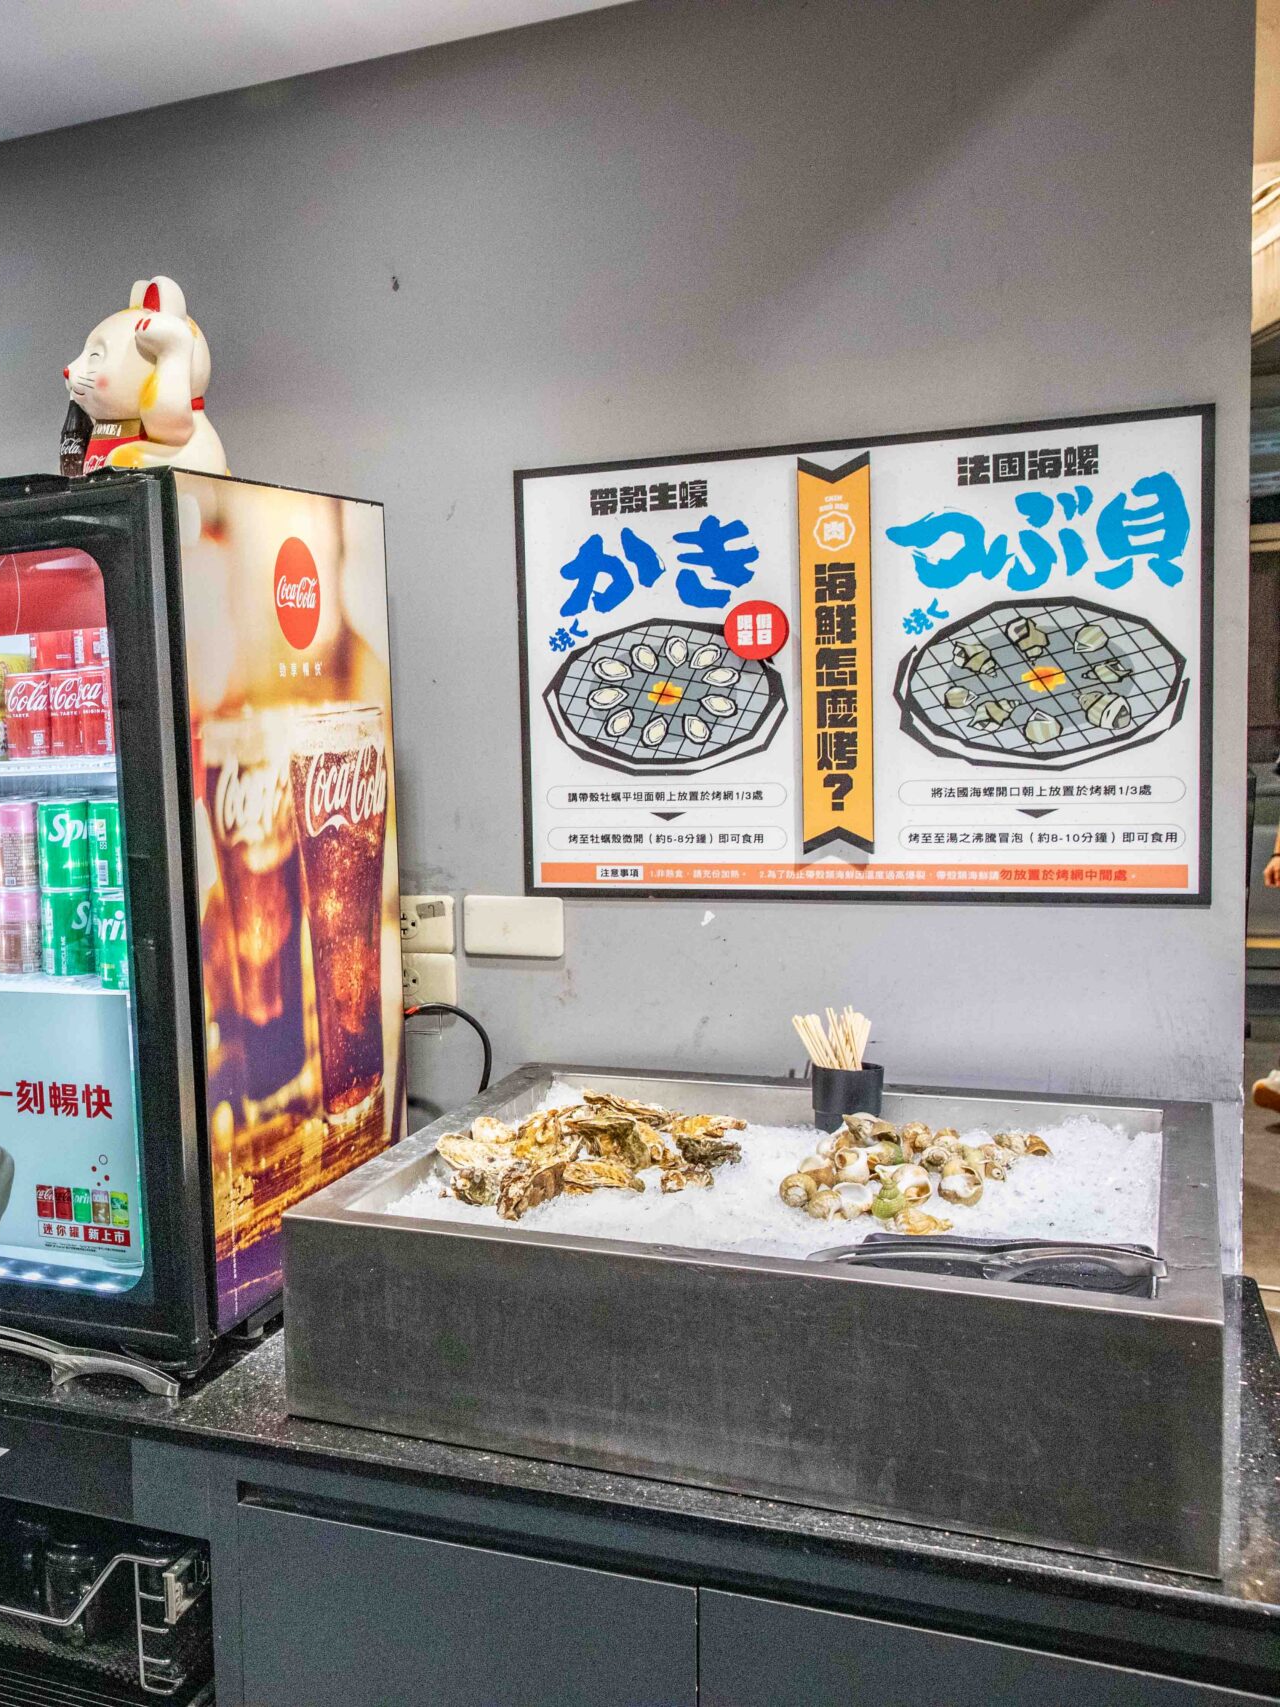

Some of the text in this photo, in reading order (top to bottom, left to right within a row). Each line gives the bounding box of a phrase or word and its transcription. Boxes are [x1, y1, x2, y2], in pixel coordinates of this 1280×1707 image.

[957, 444, 1099, 486] 法國海螺
[590, 480, 708, 516] 帶殼生蠔
[885, 471, 1190, 592] つぶ貝
[560, 515, 760, 617] かき
[276, 575, 318, 609] Coca-Cola
[305, 743, 386, 837] Coca-Cola
[600, 868, 639, 878] 注意事項
[43, 1223, 125, 1243] 迷你罐 新上市
